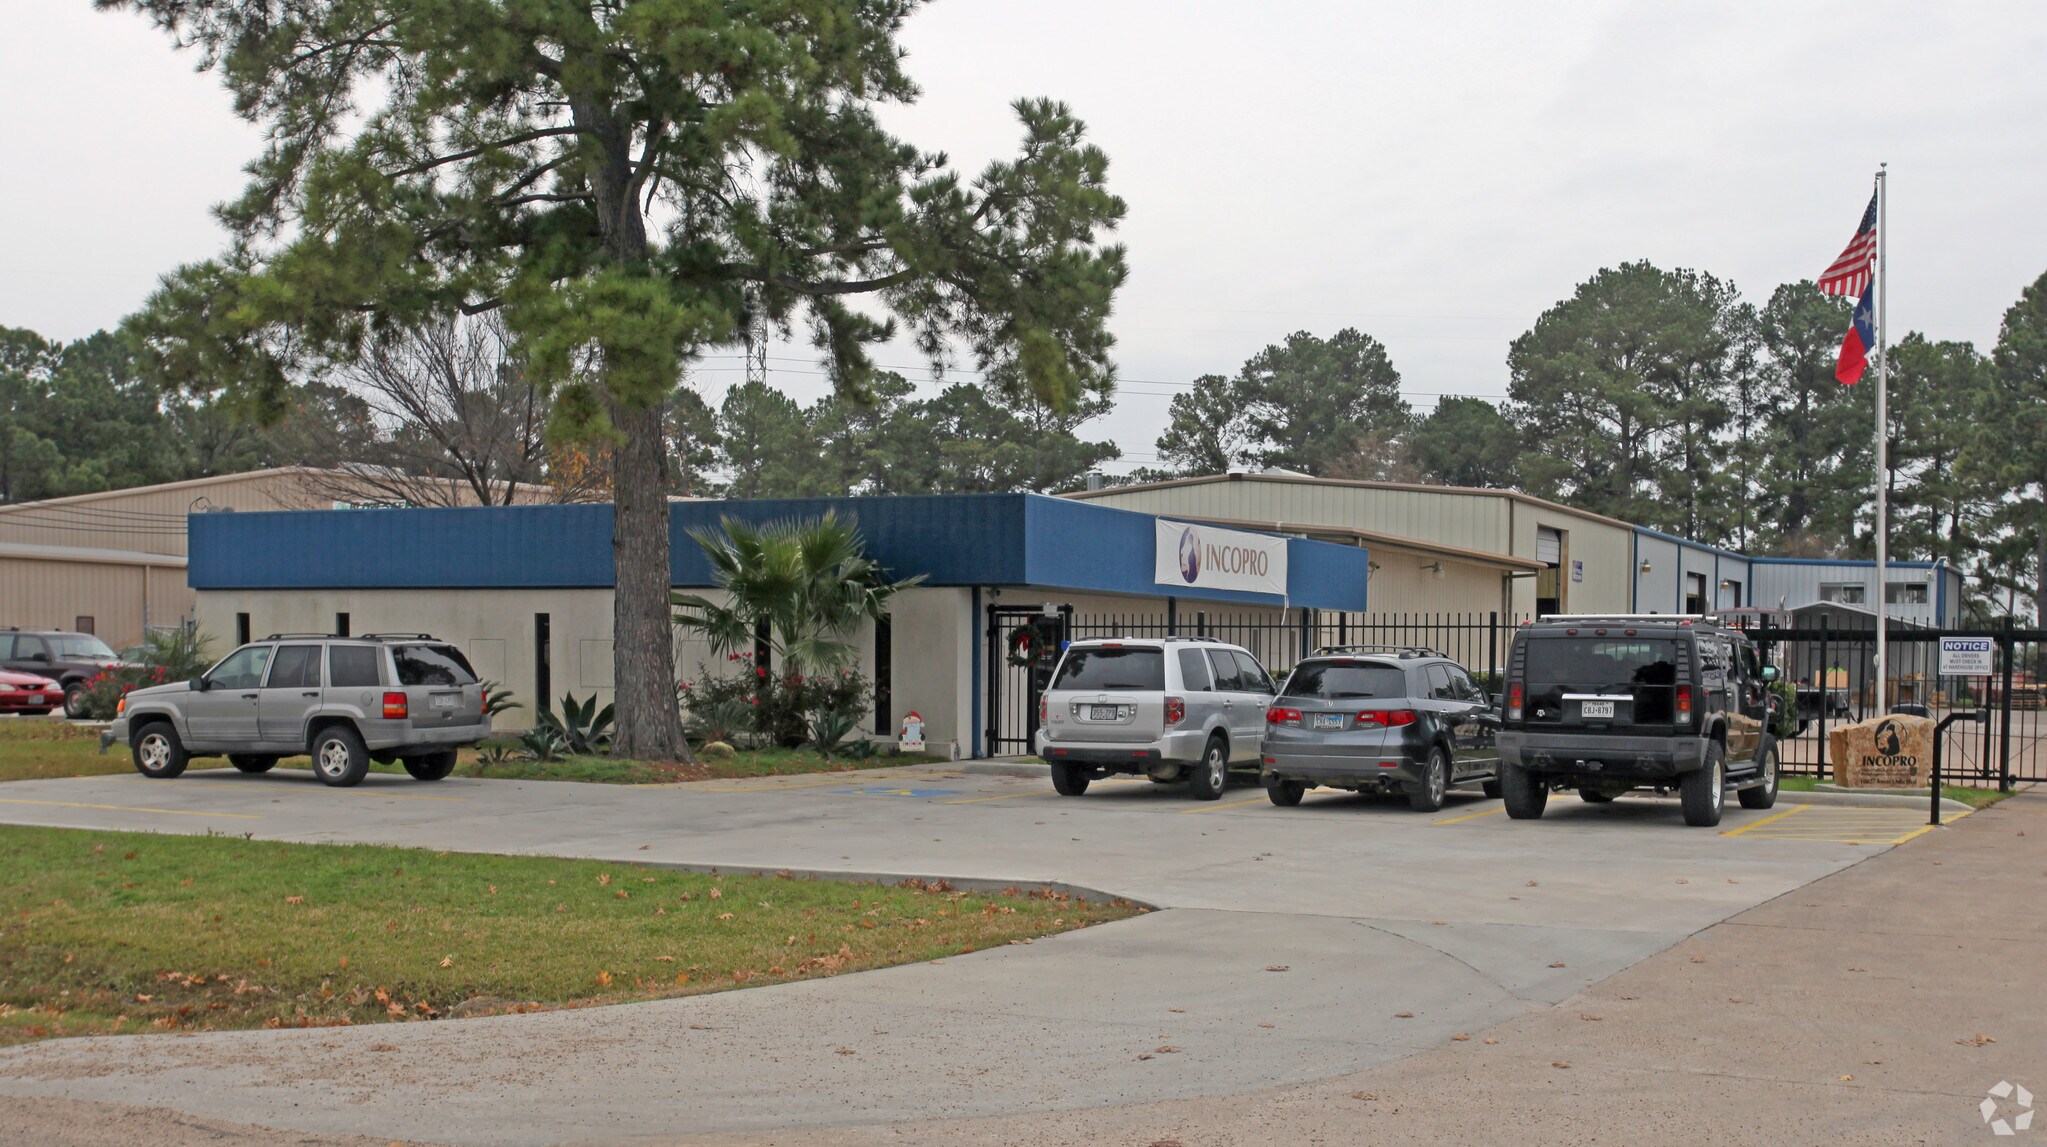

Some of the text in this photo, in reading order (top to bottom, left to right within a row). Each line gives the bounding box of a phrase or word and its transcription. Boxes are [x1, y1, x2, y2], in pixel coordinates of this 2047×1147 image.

[1206, 544, 1268, 576] INCOPRO
[1945, 642, 1987, 651] NOTICE
[1863, 755, 1917, 767] INCOPRO
